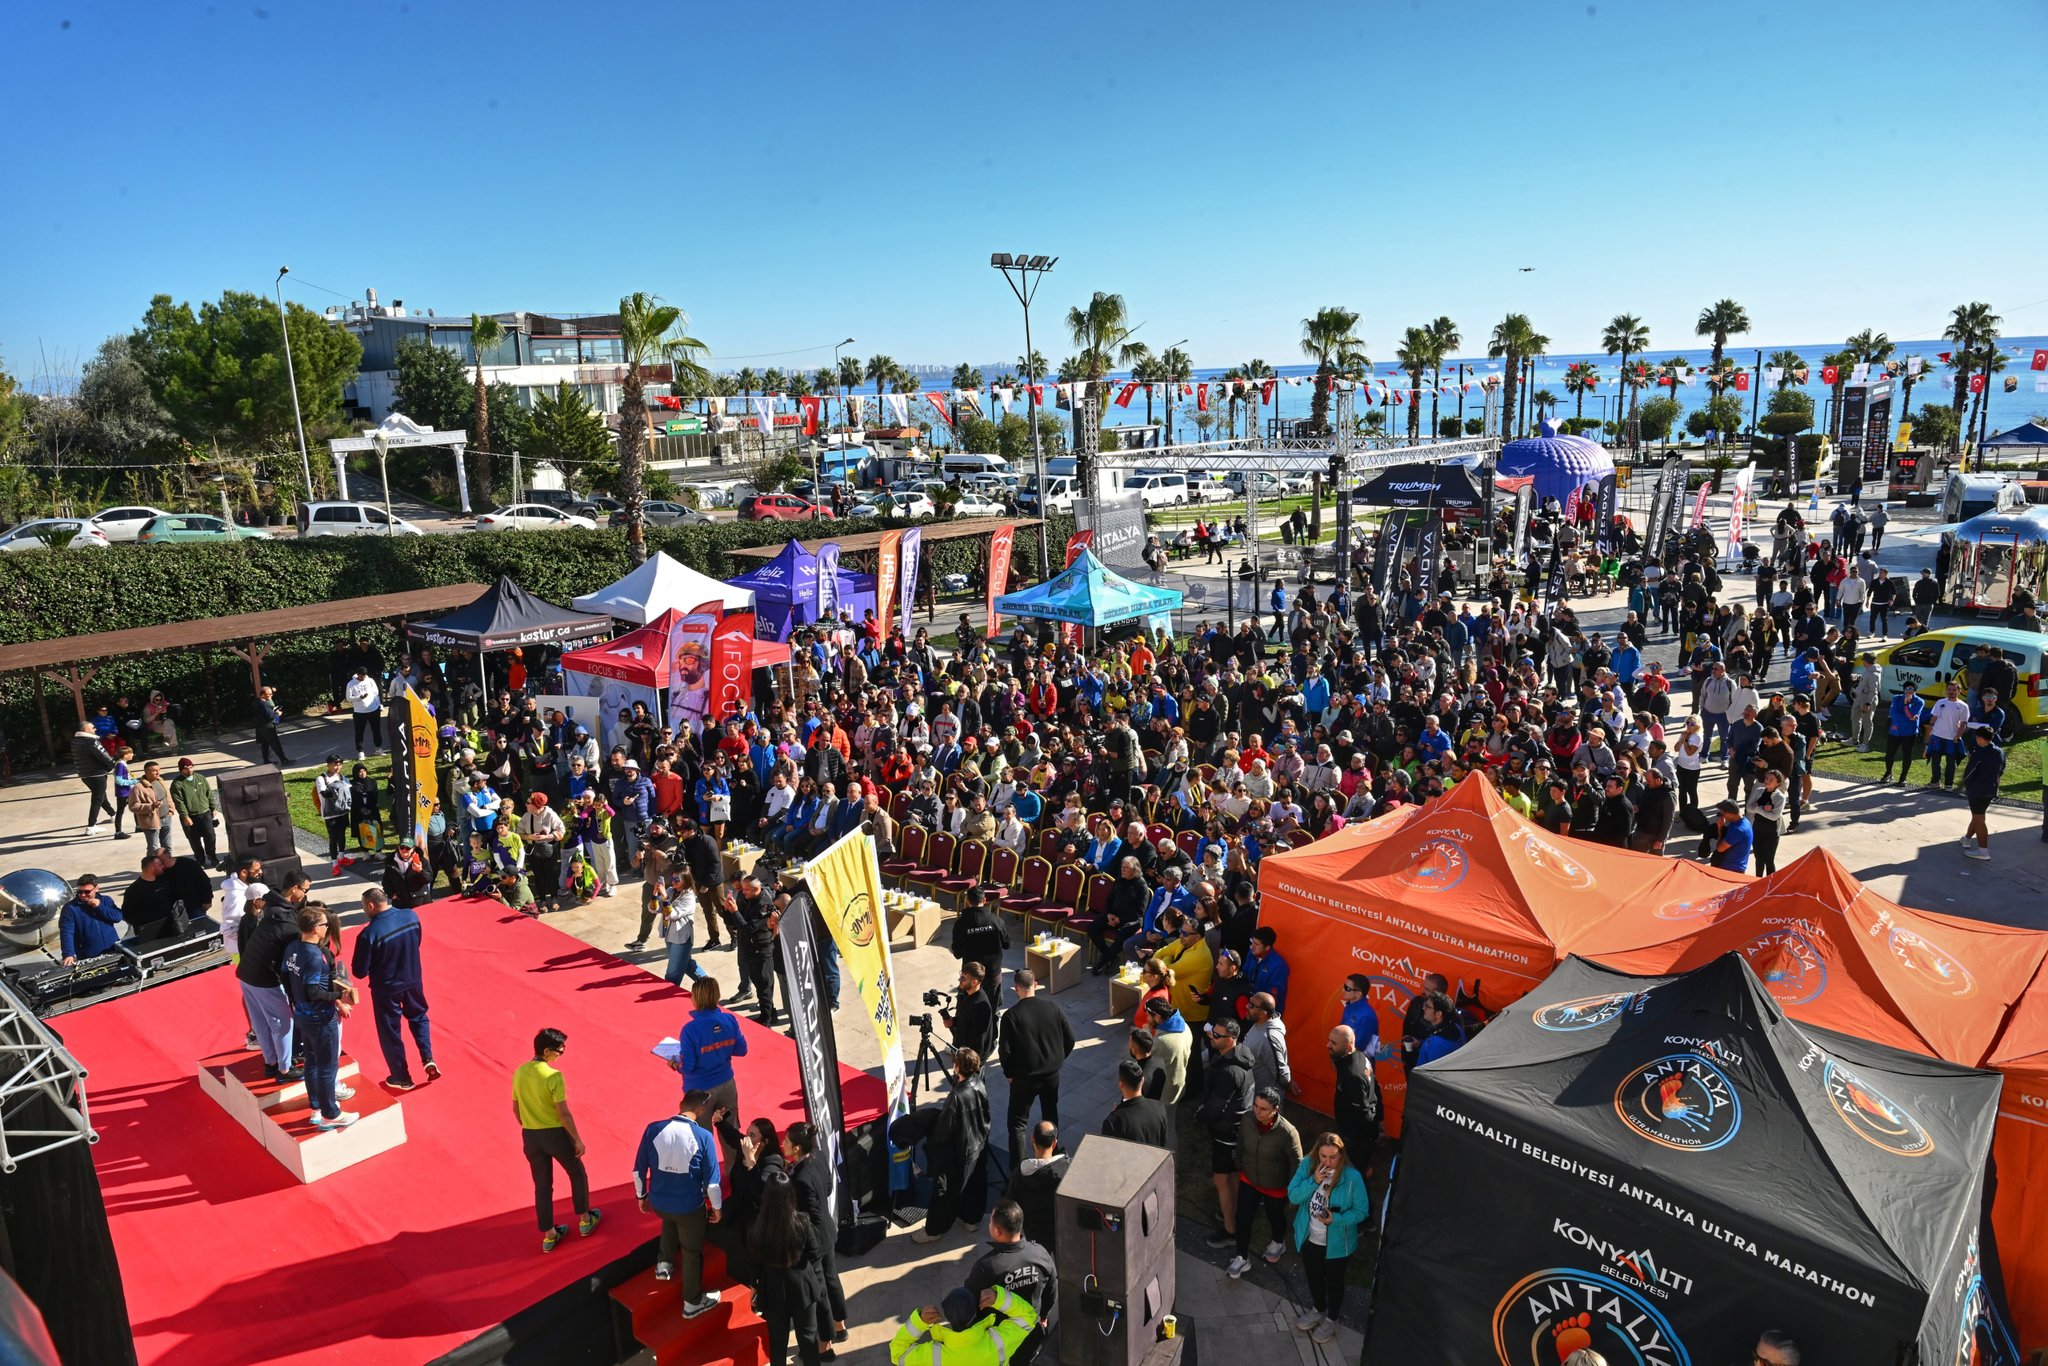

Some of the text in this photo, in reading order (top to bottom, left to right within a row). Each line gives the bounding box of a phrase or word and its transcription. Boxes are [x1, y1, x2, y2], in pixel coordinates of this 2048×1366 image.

[670, 422, 698, 432] SUBWAY
[1388, 481, 1442, 492] TRIUMPH
[1445, 499, 1472, 507] TRIUMPH
[1600, 485, 1609, 536] ZENOVA
[1420, 531, 1433, 587] NOVA
[754, 566, 785, 578] Heliz
[798, 589, 813, 598] Heliz
[1032, 604, 1055, 614] ULTRA
[1131, 602, 1153, 612] ULTRA
[757, 616, 777, 634] eliz
[587, 663, 613, 677] FOCUS
[1410, 841, 1461, 867] ANTALYA
[1278, 882, 1528, 965] KONYAALTI BELEDİYESİ ANTALYA ULTRA MARATHON
[1747, 935, 1816, 971] ANTALYA
[1643, 1059, 1730, 1109] ANTALYA
[1629, 1114, 1702, 1145] ULTRAMARATHON
[1436, 1104, 1876, 1308] KONYAALTI BELEDİYESİ ANTALYA ULTRA MARATHON
[1004, 1266, 1039, 1284] ÖZEL
[1005, 1275, 1039, 1292] GÜVENLİK
